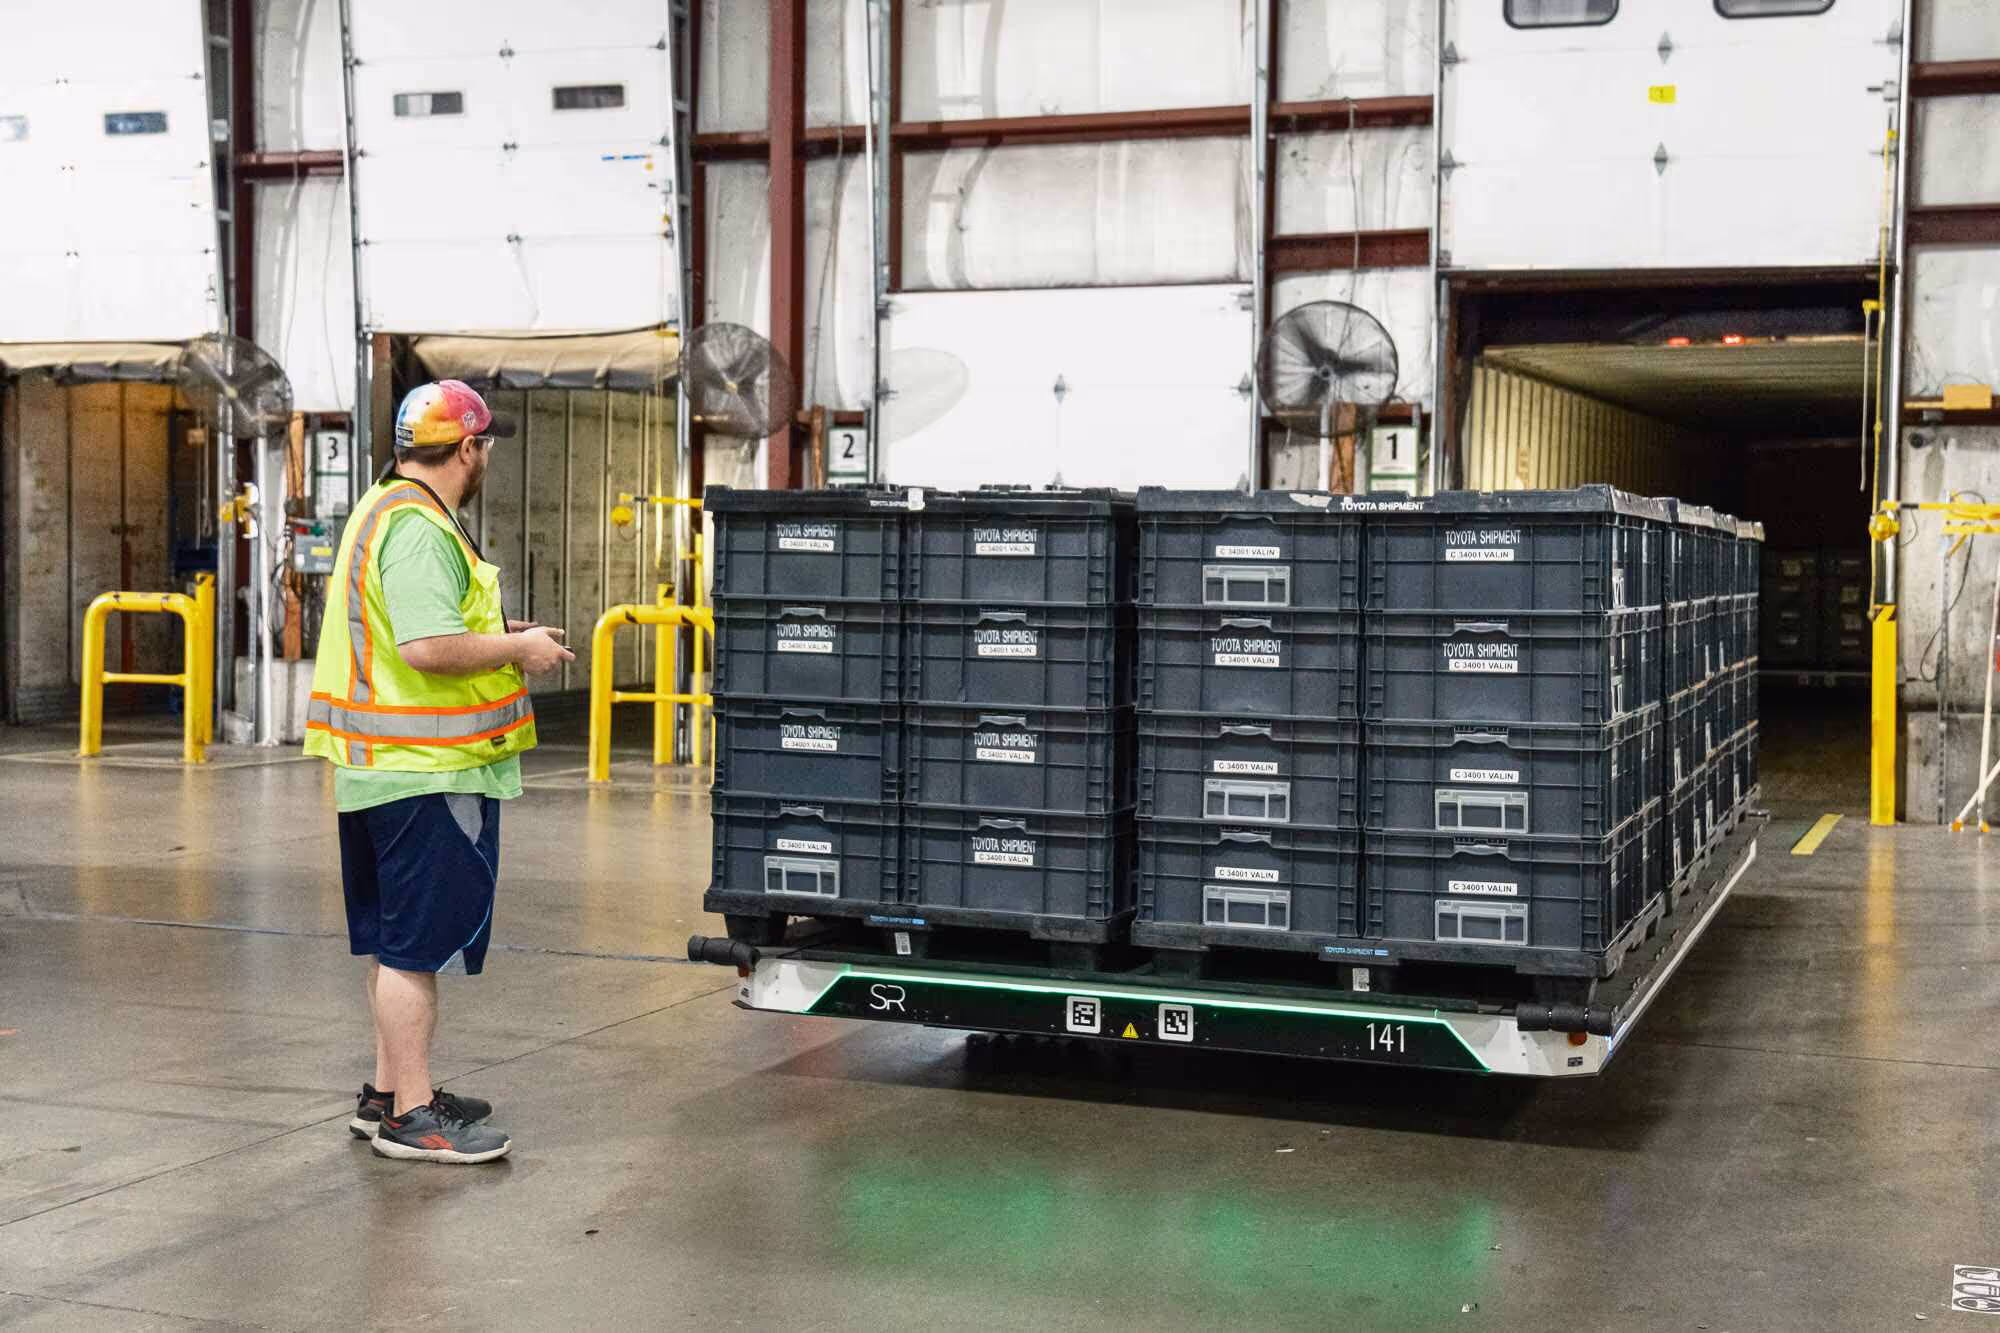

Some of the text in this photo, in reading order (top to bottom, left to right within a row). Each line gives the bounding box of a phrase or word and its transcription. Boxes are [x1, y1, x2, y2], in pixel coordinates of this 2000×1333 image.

[328, 436, 338, 460] 3
[843, 433, 855, 459] 2
[1386, 433, 1398, 460] 1
[1340, 502, 1424, 511] TOYOTA SHIPMENT
[777, 524, 837, 537] TOYOTA SHIPMENT
[973, 528, 1038, 542] TOYOTA SHIPMENT
[1445, 530, 1520, 544] TOYOTA SHIPMENT
[810, 541, 830, 549] VALIN
[1459, 551, 1481, 559] 34001
[776, 624, 836, 637] TOYOTA SHIPMENT
[974, 630, 1039, 644] TOYOTA SHIPMENT
[809, 643, 829, 651] VALIN
[1211, 638, 1281, 653] TOYOTA SHIPMENT
[1443, 643, 1518, 658] TOYOTA SHIPMENT
[1228, 656, 1249, 664] 34001
[1463, 662, 1485, 670] 34001
[1488, 662, 1513, 670] VALIN
[781, 725, 841, 739] TOYOTA SHIPMENT
[974, 733, 1038, 747] TOYOTA SHIPMENT
[808, 843, 828, 851] VALIN
[972, 837, 1036, 853] TOYOTA SHIPMENT
[1250, 871, 1274, 879] VALIN
[870, 984, 905, 1011] SR
[1366, 1023, 1405, 1052] 141
